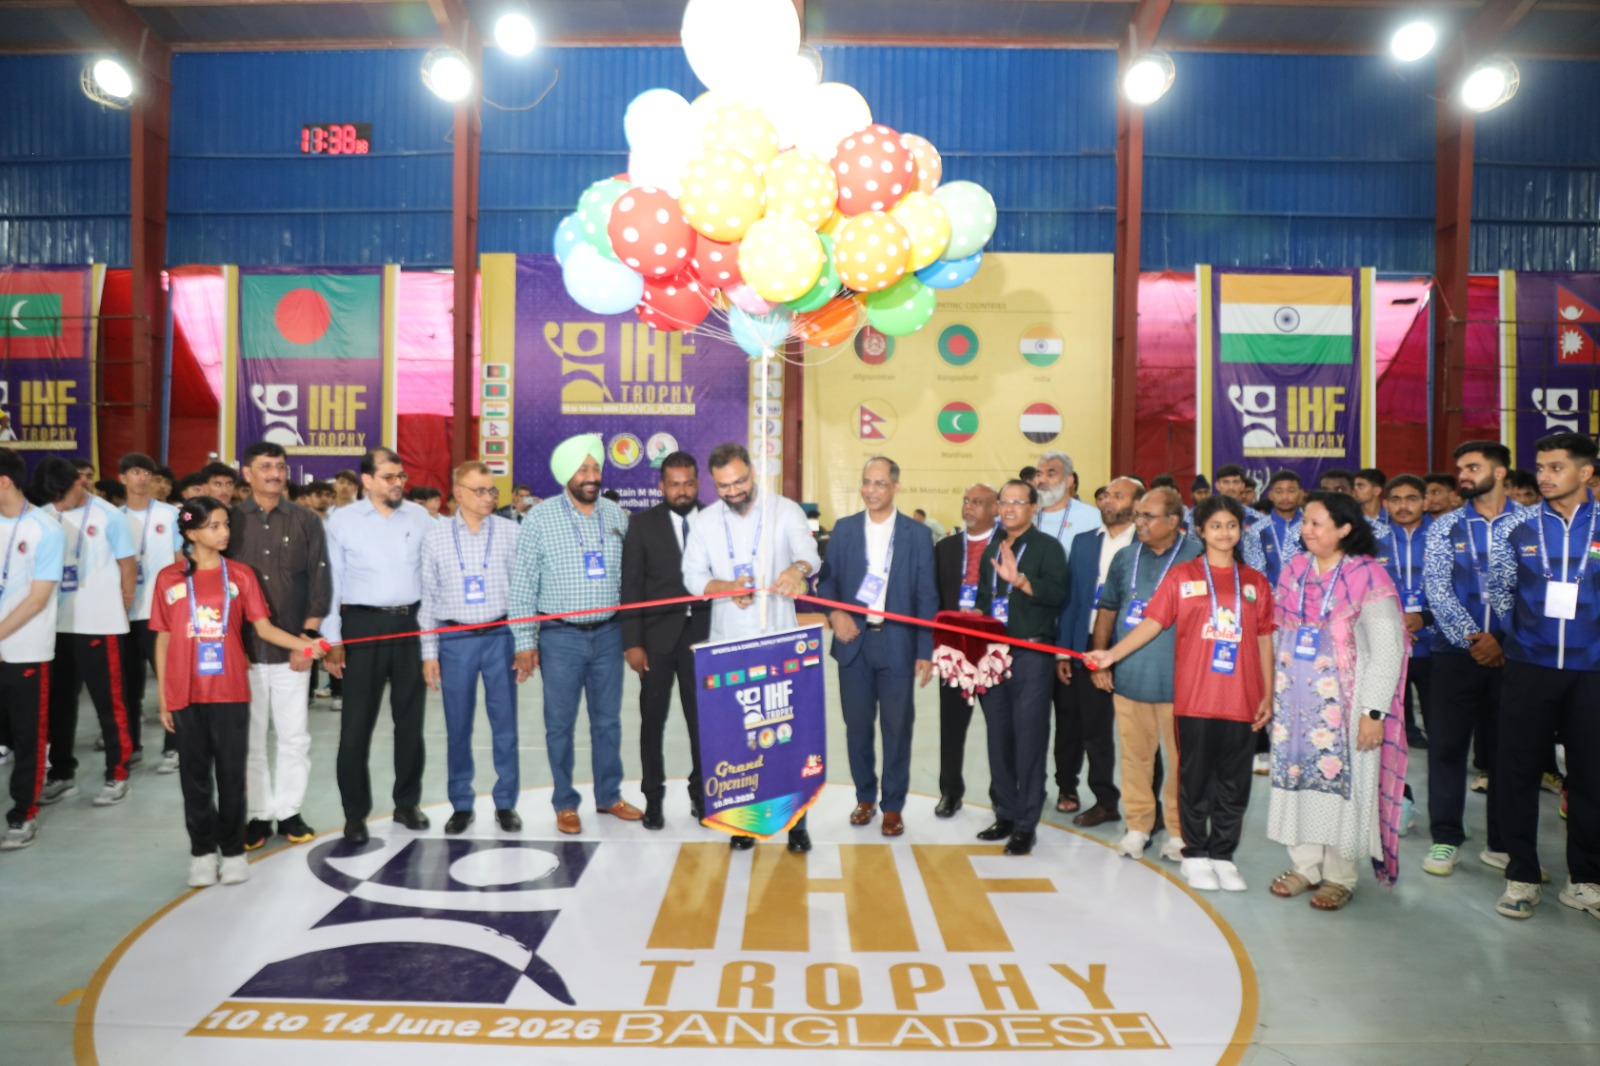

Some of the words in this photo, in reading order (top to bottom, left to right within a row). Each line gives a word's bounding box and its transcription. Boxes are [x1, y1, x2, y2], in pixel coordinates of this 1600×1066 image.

[620, 322, 696, 382] IHF
[937, 374, 979, 383] Bangladesh
[21, 381, 77, 425] IHF
[620, 385, 695, 403] TROPHY
[308, 385, 367, 430] IHF
[620, 403, 695, 413] BANGLADESH
[1287, 386, 1345, 432] IHF
[22, 427, 76, 440] TROPHY
[309, 433, 366, 446] TROPHY
[1288, 434, 1345, 448] TROPHY
[764, 679, 793, 711] IHF
[766, 706, 794, 719] TROPHY
[715, 754, 764, 778] Grand
[705, 773, 759, 799] Opening
[646, 842, 1057, 952] IHF
[639, 960, 1115, 1011] TROPHY
[205, 1009, 260, 1031] 10
[262, 1011, 309, 1032] to
[322, 1012, 376, 1034] 14
[374, 1013, 482, 1037] June
[488, 1017, 602, 1040] 2026
[612, 1012, 1166, 1048] BANGLADESH
